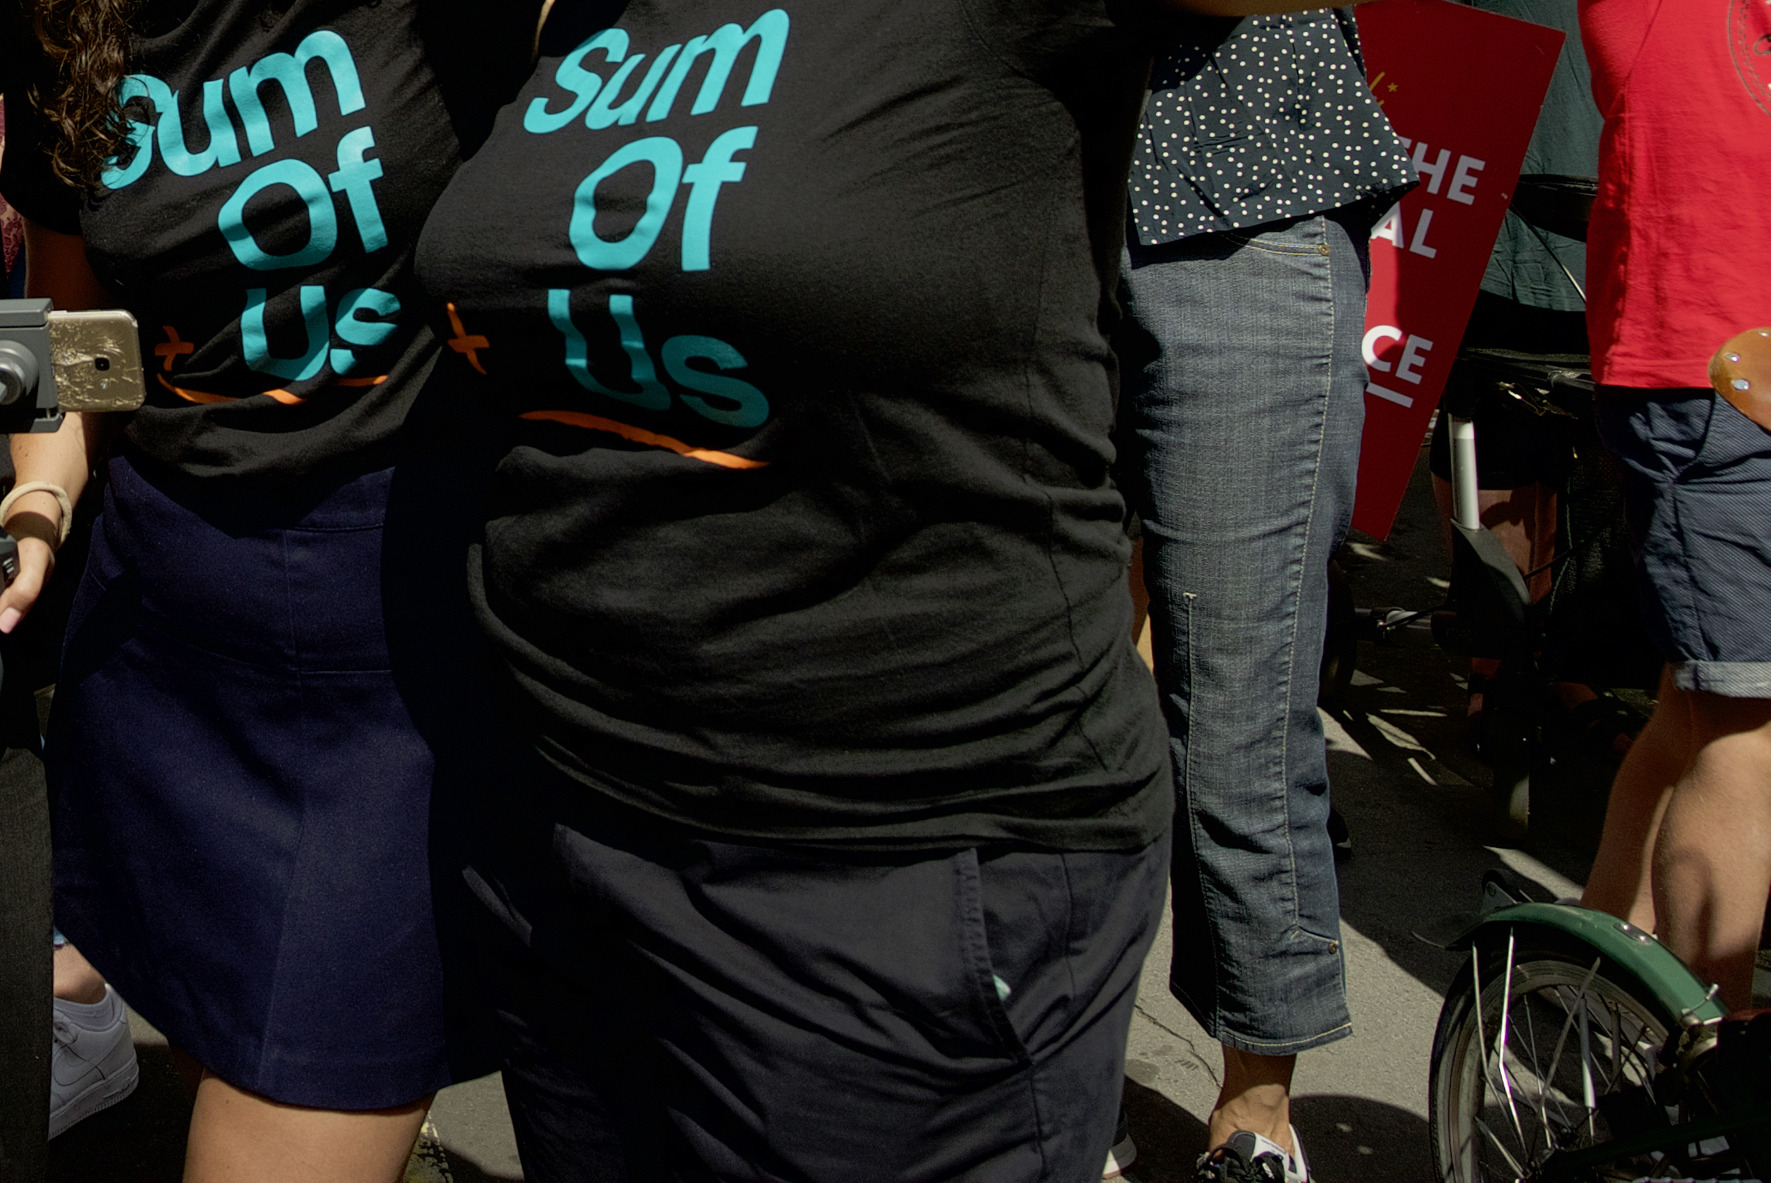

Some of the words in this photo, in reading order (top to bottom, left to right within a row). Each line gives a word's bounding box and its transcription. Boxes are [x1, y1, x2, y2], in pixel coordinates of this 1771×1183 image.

[100, 29, 366, 191] Sum
[523, 8, 790, 134] Sum
[218, 125, 389, 272] Of
[568, 125, 760, 272] Of
[239, 284, 402, 383] Us
[547, 288, 770, 429] Us
